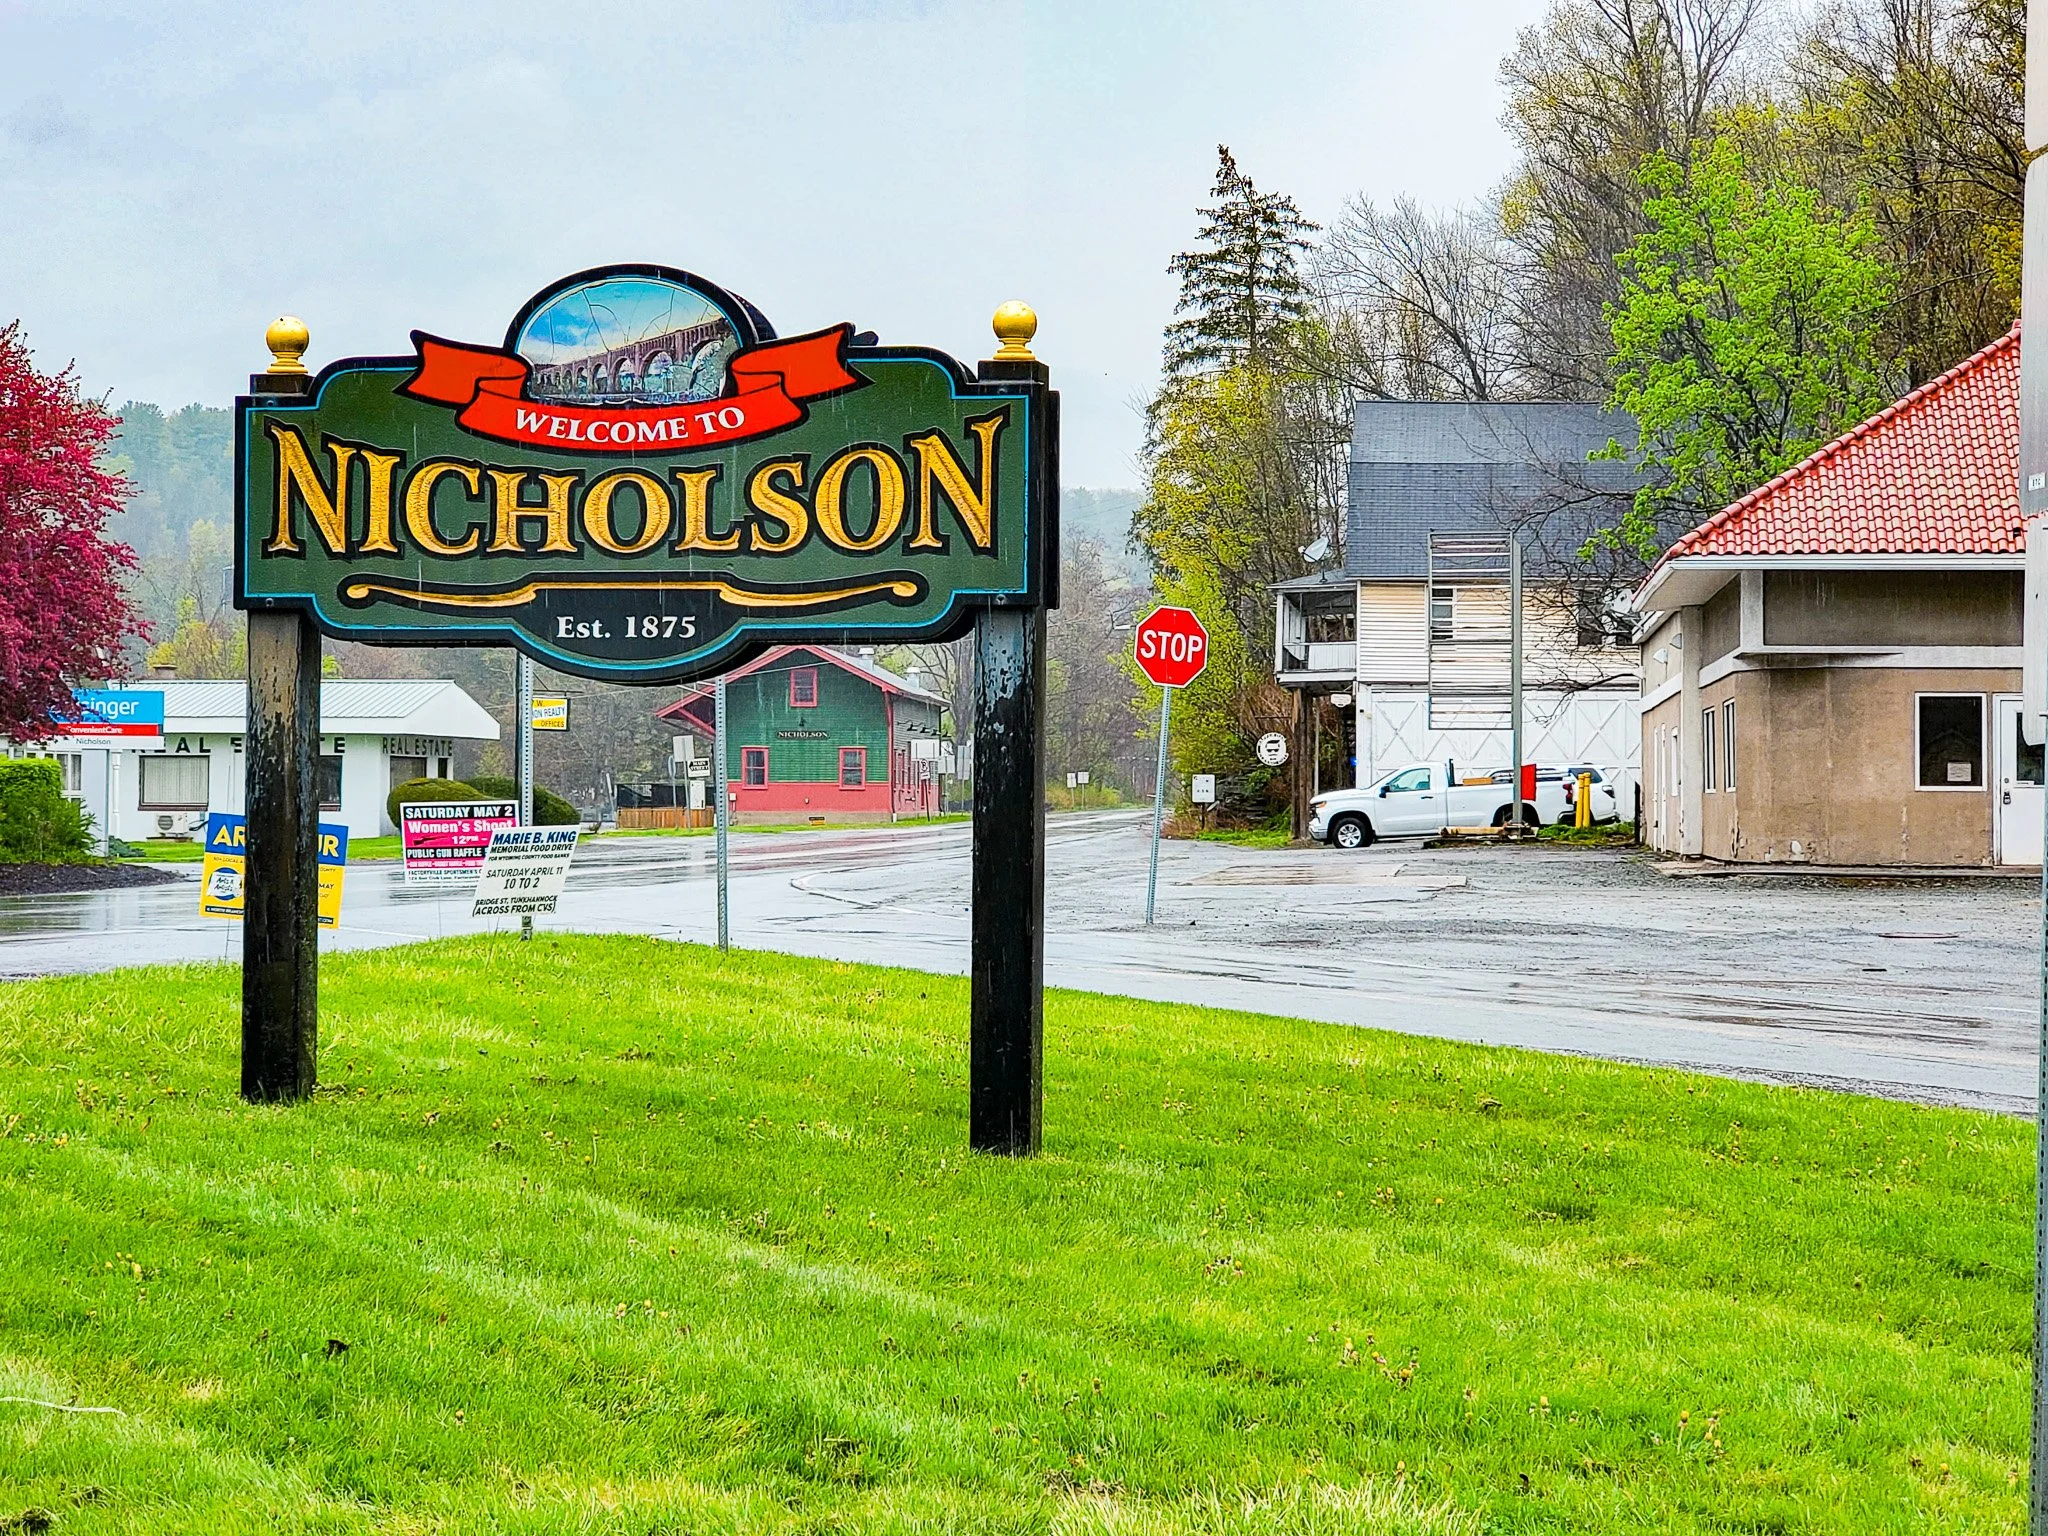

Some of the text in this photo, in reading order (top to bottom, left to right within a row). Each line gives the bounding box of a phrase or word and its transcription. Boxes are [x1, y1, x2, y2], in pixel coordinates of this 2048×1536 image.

[516, 406, 745, 443] WELCOME TO
[270, 414, 1005, 554] NICHOLSON
[556, 615, 696, 638] Est. 1875
[1140, 629, 1203, 663] STOP
[77, 697, 139, 720] singer
[544, 706, 566, 717] REALTY
[382, 737, 453, 757] REAL ESTATE
[405, 805, 513, 818] SATURDAY MAY 2
[408, 820, 471, 834] Women's
[492, 831, 577, 845] MARIE B. KING
[407, 847, 482, 858] PUBLIC GUN RAFFLE
[490, 843, 573, 853] MEMORIAL FOOD DRIVE
[486, 867, 530, 878] SATURDAY
[530, 866, 554, 876] APRIL
[556, 866, 563, 875] 11
[504, 877, 540, 889] 10 TO 2
[475, 898, 499, 906] BRIDGE
[510, 895, 559, 904] TUNKHANNOCK
[472, 904, 509, 917] (ACROSS
[510, 903, 535, 914] FROM
